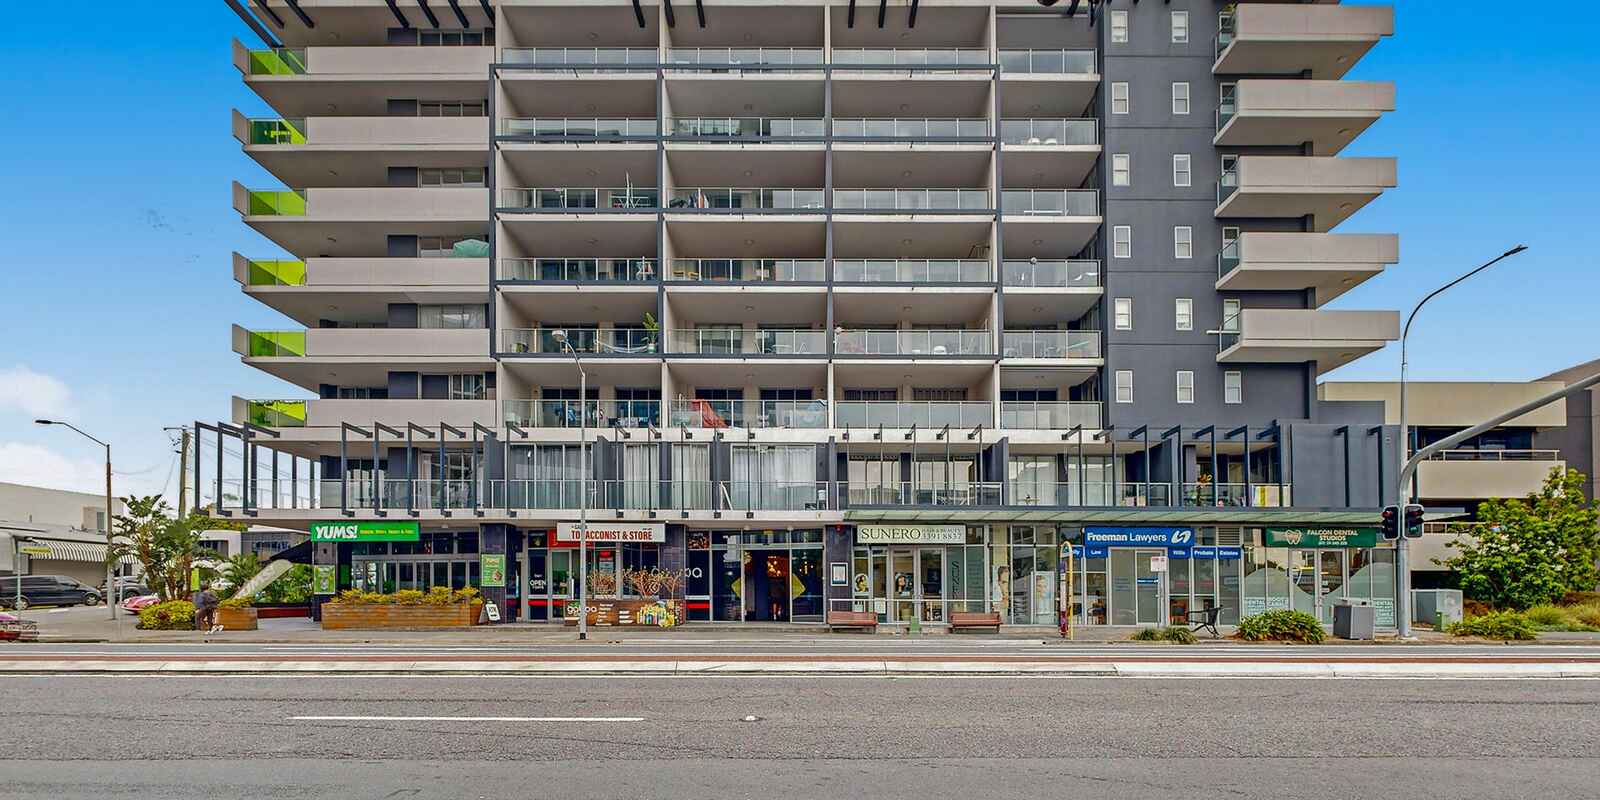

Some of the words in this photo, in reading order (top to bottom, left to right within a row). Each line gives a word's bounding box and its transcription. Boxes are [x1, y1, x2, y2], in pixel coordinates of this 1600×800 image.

[315, 525, 358, 539] YUMS!
[571, 530, 620, 540] TOACCONIST
[622, 530, 629, 540] &
[630, 530, 653, 540] STORE
[861, 528, 921, 540] SUNERO
[1087, 533, 1128, 541] Freeman
[1129, 533, 1167, 544] Lawyers
